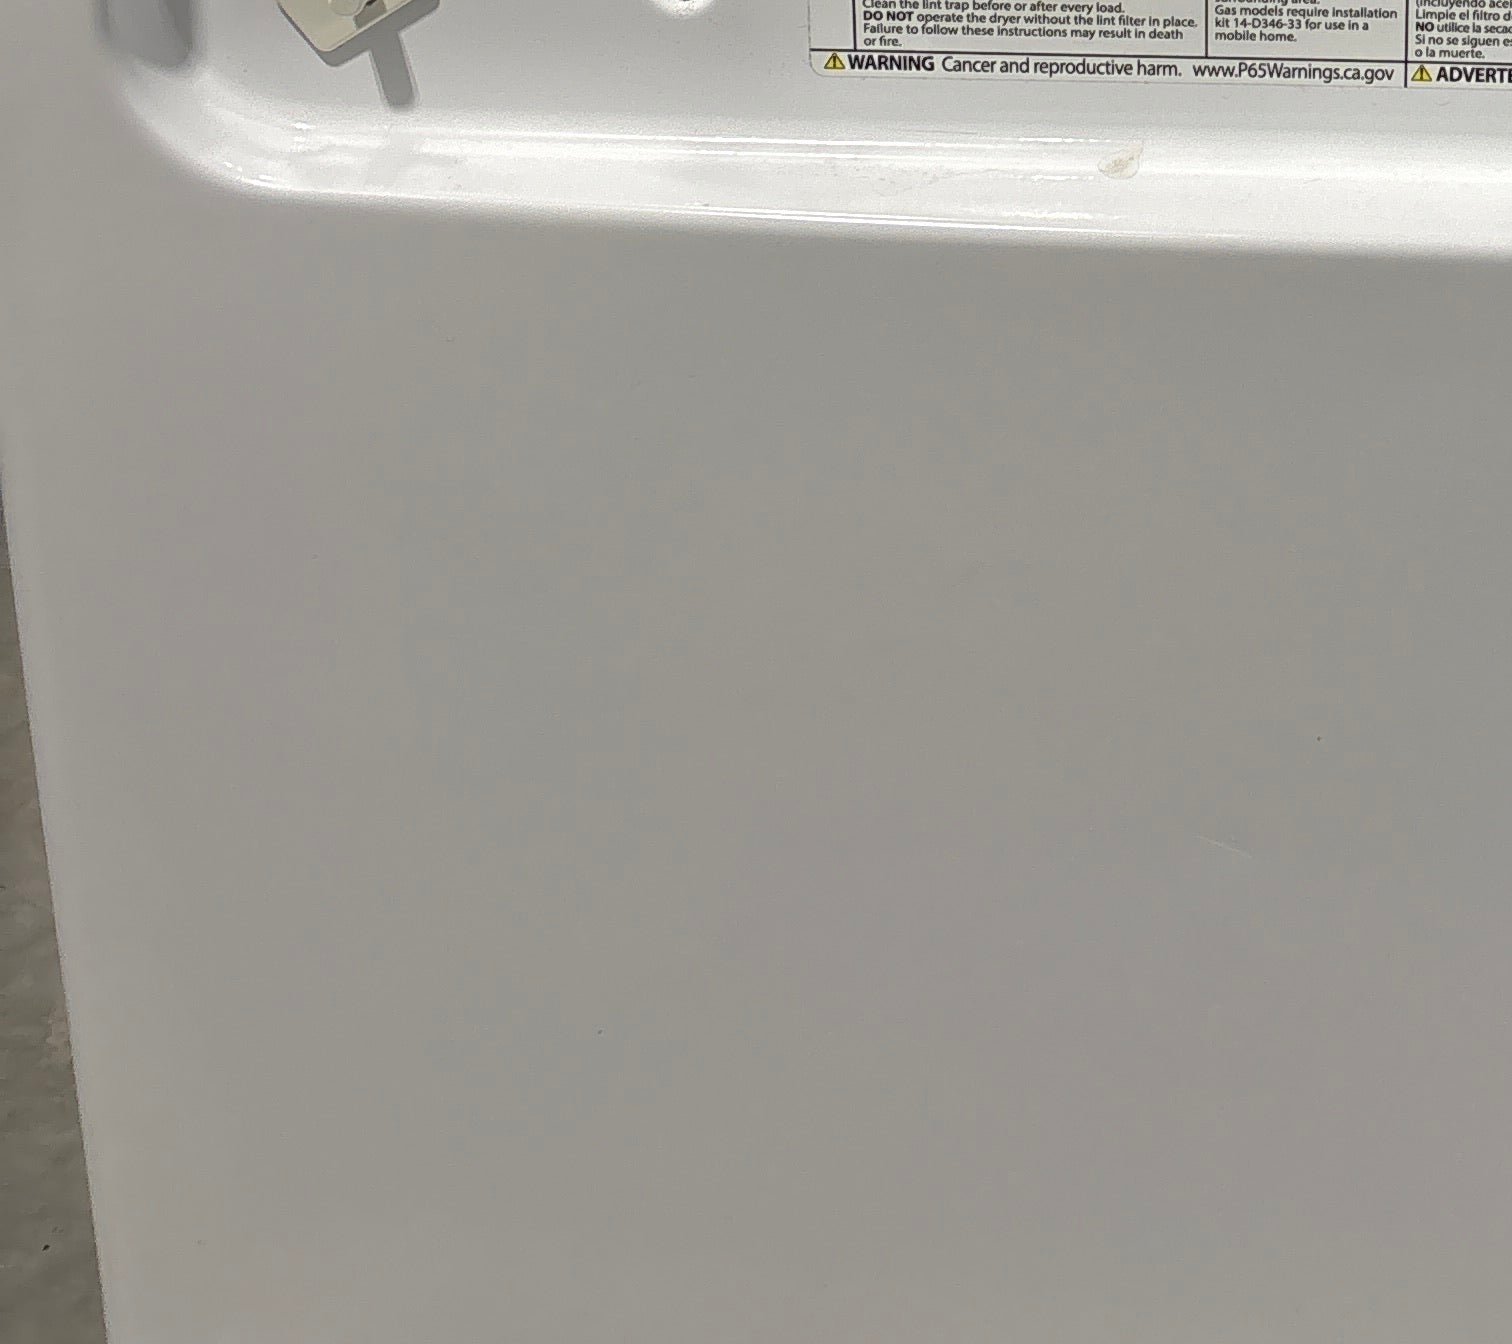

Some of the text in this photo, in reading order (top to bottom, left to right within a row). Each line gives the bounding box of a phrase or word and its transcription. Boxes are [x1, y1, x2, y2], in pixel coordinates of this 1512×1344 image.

[864, 23, 1184, 40] Failure to follow these instructions may result in death
[1214, 30, 1296, 41] mobile home.
[847, 54, 1395, 84] WARNING Cancer and reproductive harm. www.P65Warnings.ca.gov
